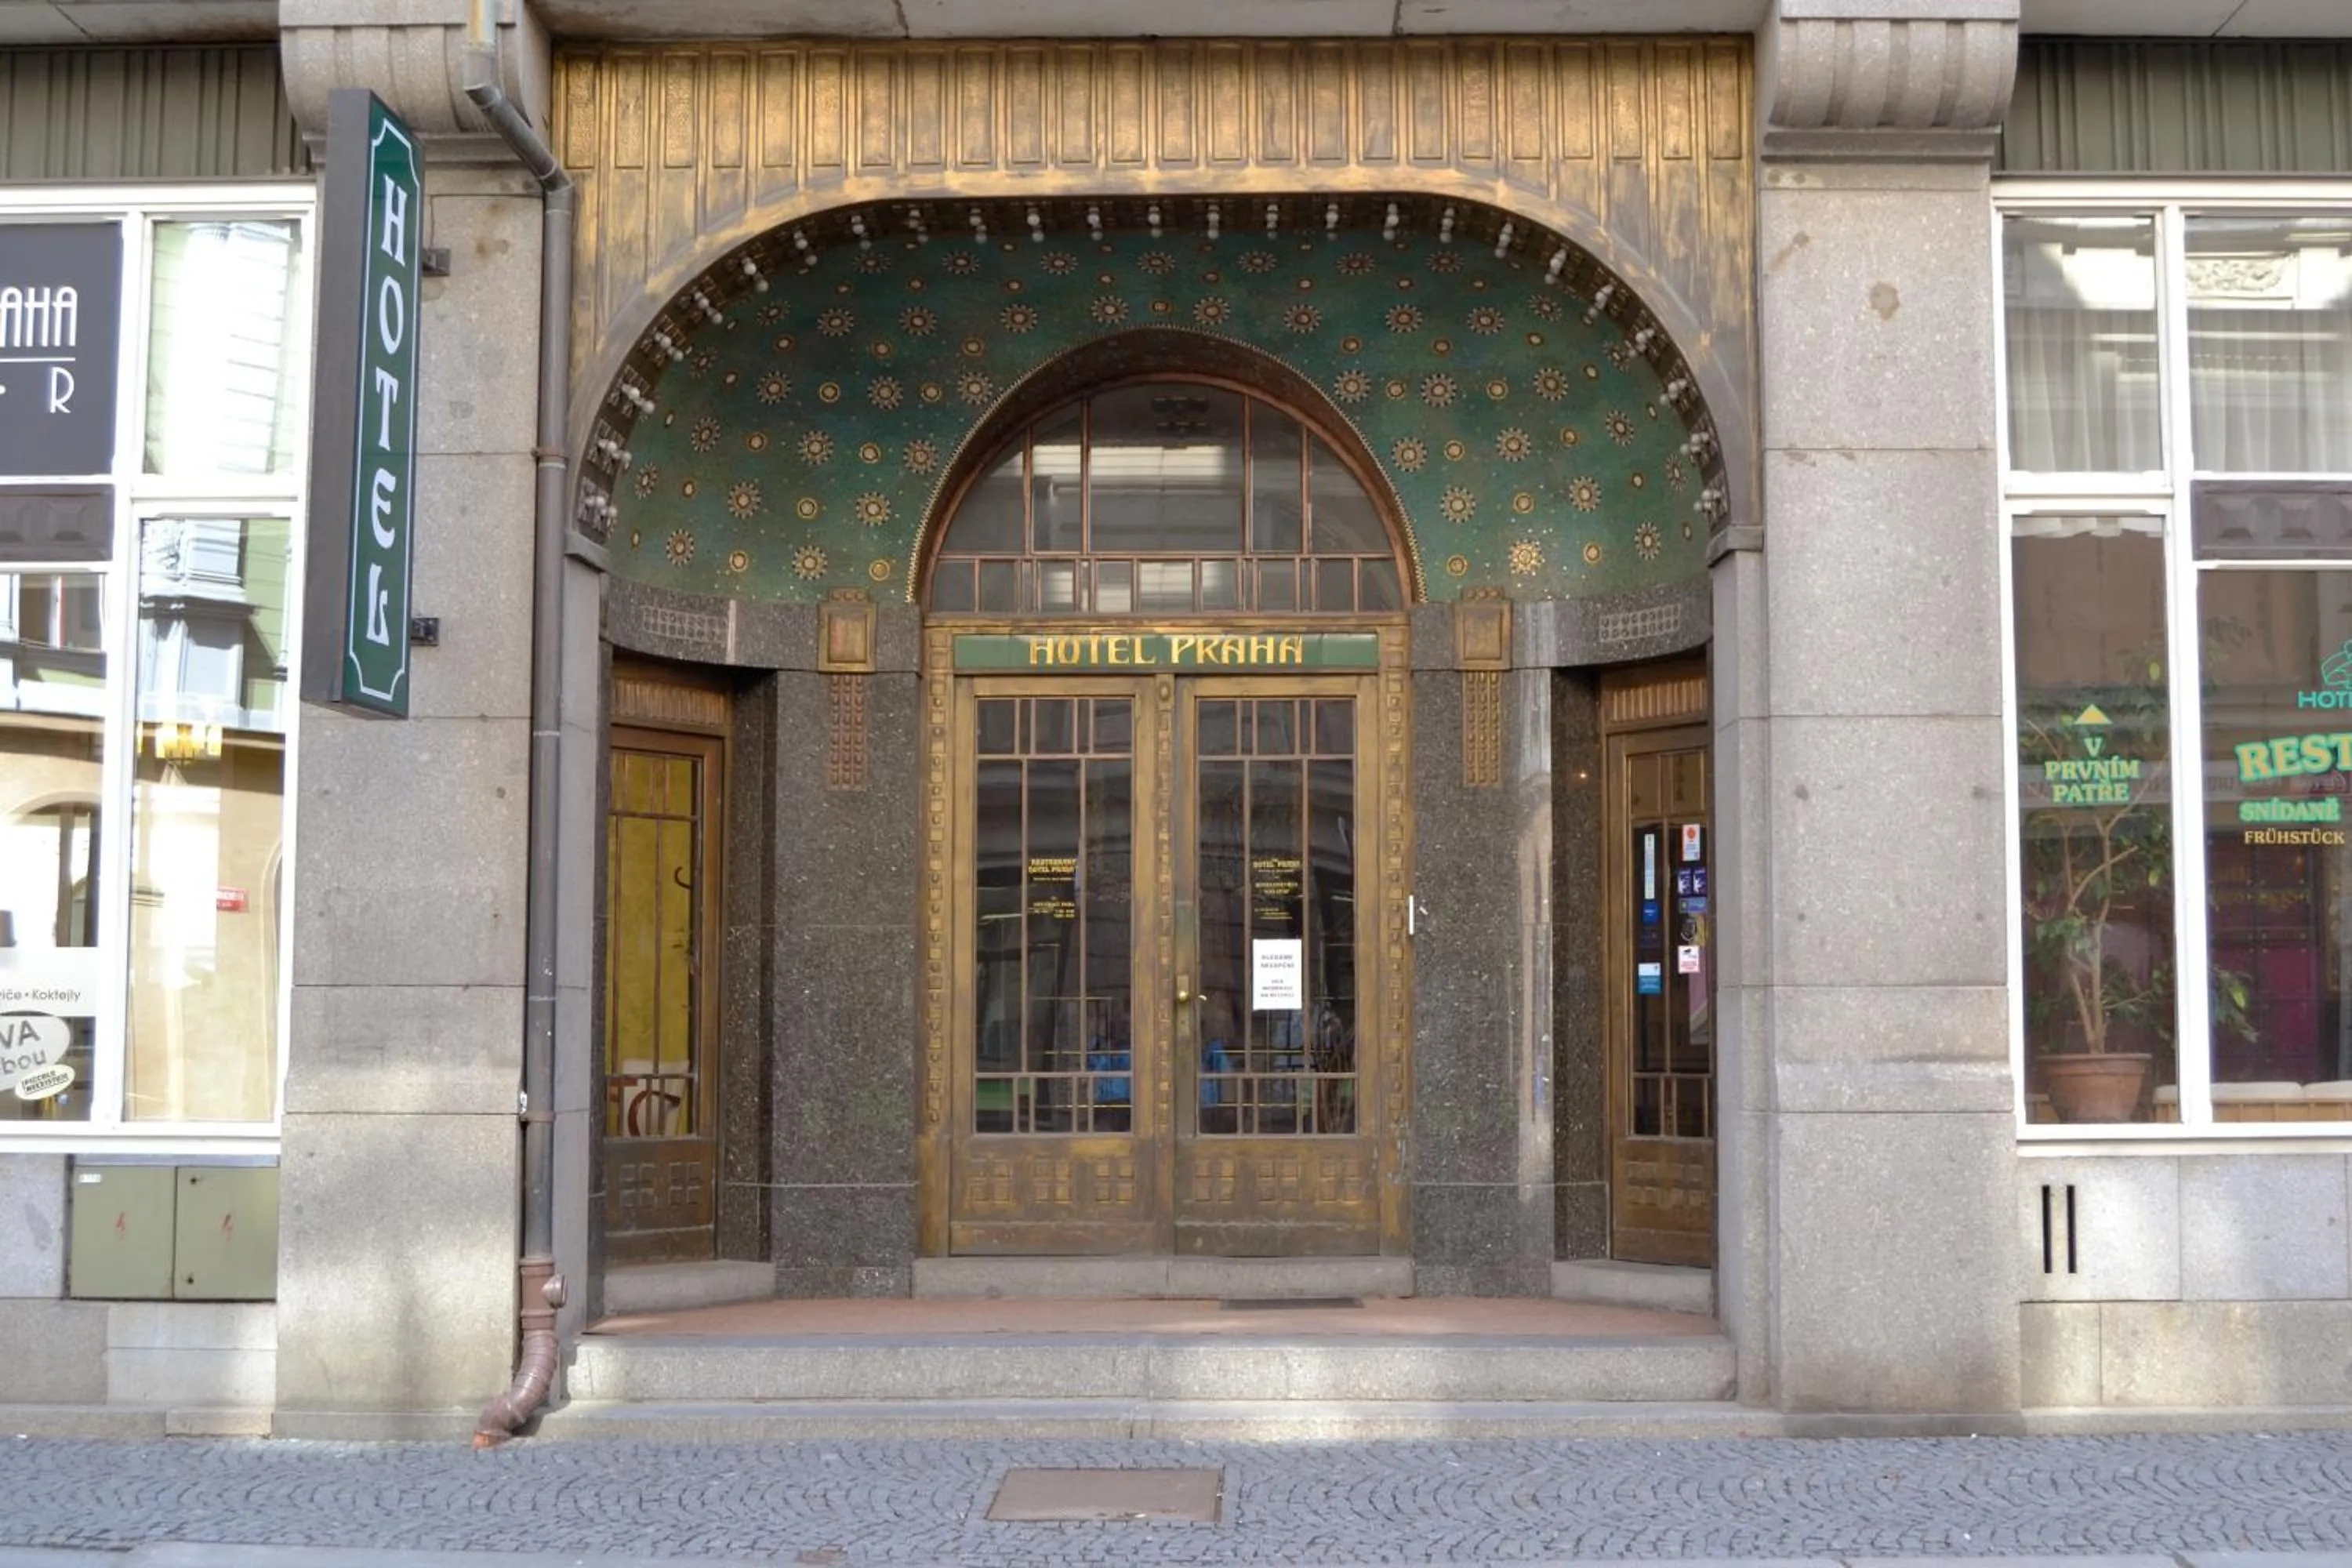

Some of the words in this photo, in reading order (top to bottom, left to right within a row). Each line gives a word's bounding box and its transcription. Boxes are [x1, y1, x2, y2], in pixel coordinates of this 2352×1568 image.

[366, 173, 408, 647] HOTEL
[1029, 636, 1155, 665] HOTEL
[1171, 635, 1304, 665] PRAHA
[2084, 738, 2103, 757] V
[2045, 755, 2140, 781] PRVNÍM
[2053, 780, 2129, 803] PATŘE
[2239, 797, 2340, 822] SNÍDANĚ
[2244, 827, 2345, 845] FRÜHSTÜCK
[32, 989, 81, 1002] Koktejly
